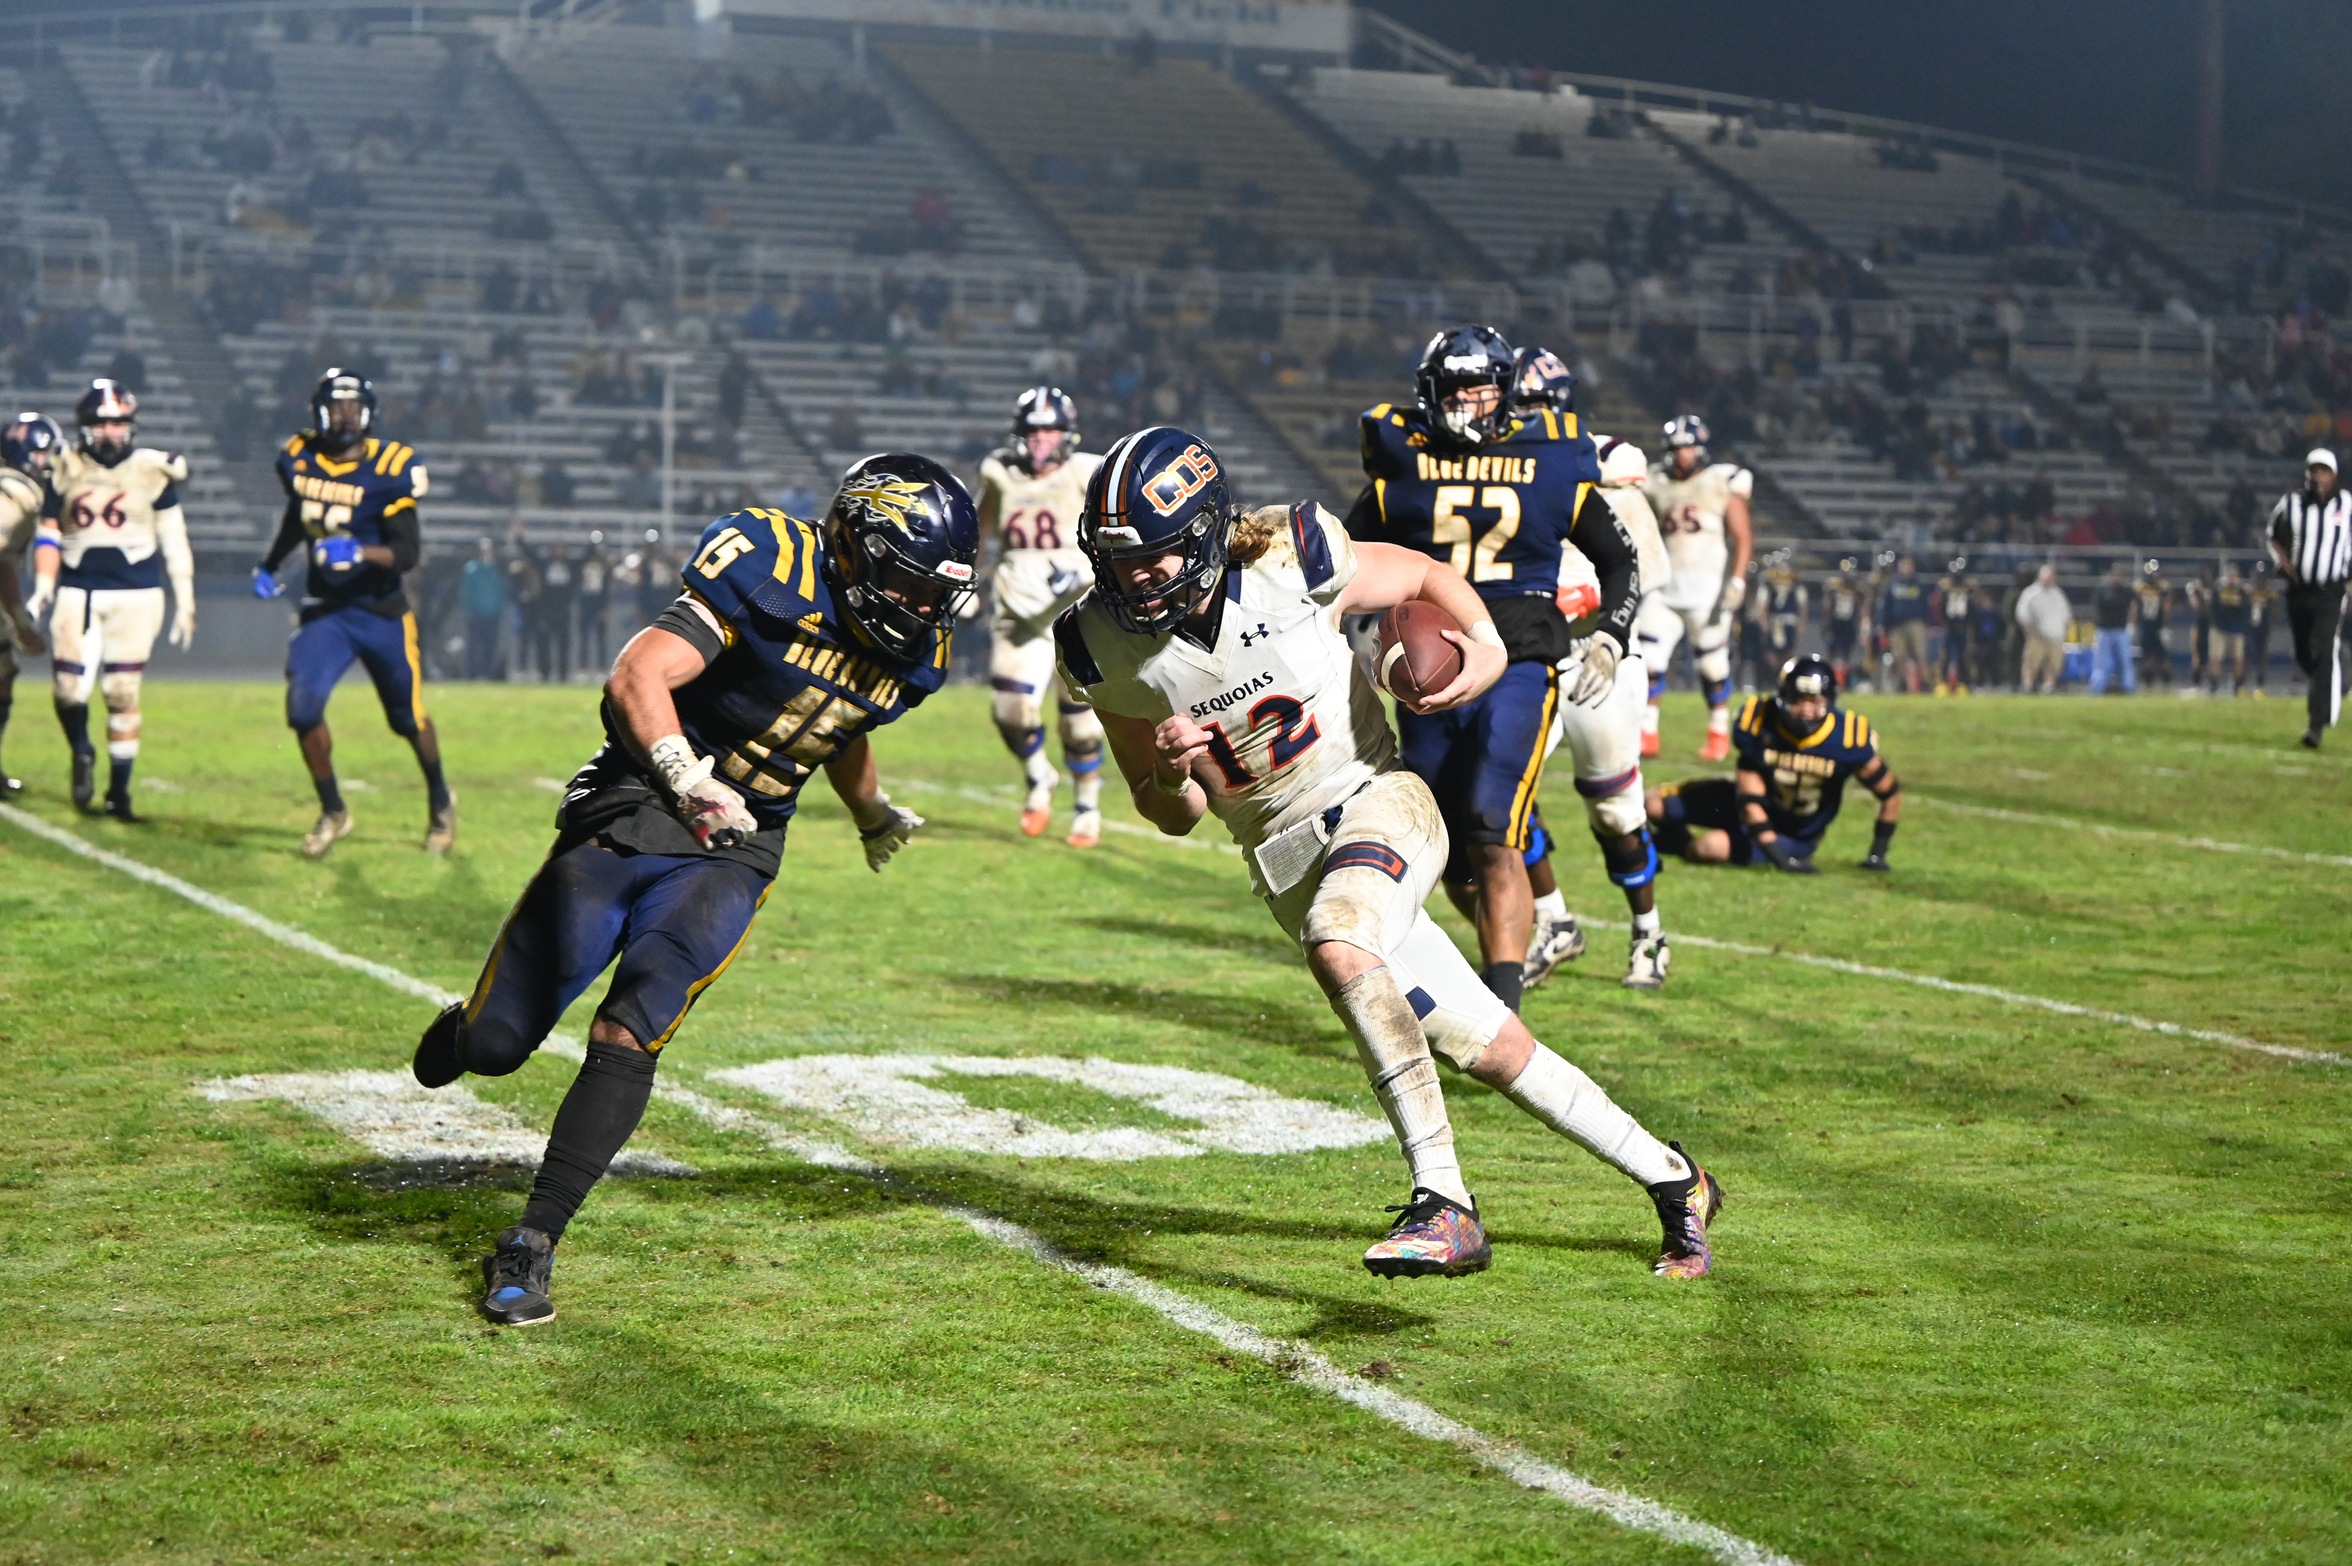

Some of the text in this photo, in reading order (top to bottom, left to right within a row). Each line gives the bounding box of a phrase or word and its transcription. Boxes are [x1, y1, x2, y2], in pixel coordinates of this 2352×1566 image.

[1142, 444, 1219, 517] COS
[1417, 453, 1536, 484] BLUE DEVILS
[70, 489, 127, 529] 66
[1003, 506, 1061, 549] 68
[1432, 485, 1521, 583] 52
[692, 527, 756, 580] 15
[783, 632, 846, 681] BLUE
[1190, 671, 1274, 718] SEQUOIAS
[722, 685, 869, 796] 15
[1200, 694, 1321, 788] 12
